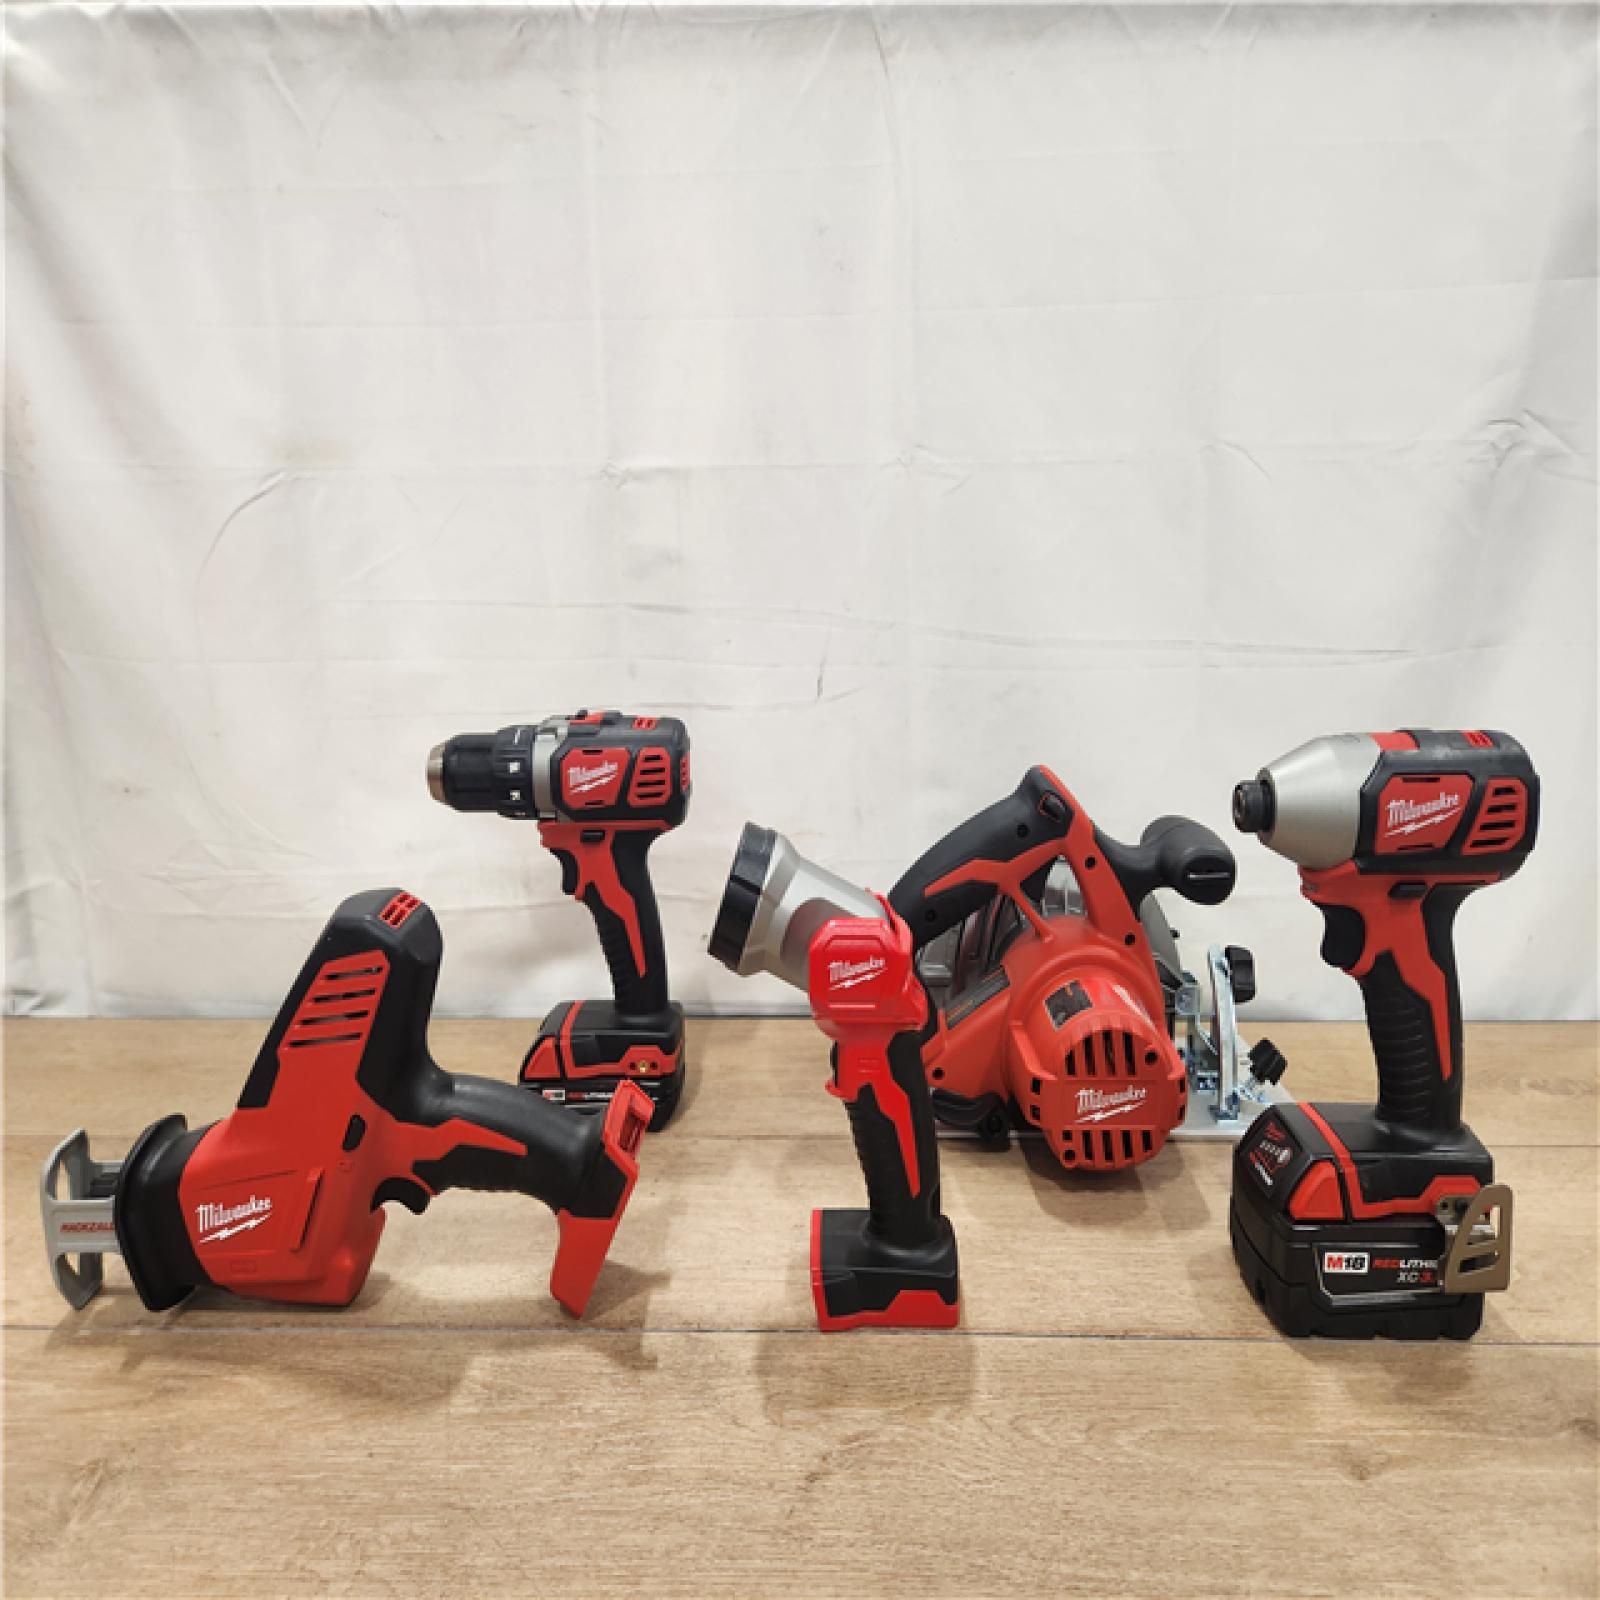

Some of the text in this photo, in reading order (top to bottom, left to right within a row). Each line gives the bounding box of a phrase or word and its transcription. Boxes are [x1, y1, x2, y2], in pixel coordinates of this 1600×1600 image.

[1385, 791, 1459, 828] Milwaukee
[828, 954, 886, 983] Milwaukee
[1075, 1084, 1148, 1115] Milwaukee
[195, 1194, 272, 1233] Milwaukee
[1326, 1255, 1366, 1270] M18
